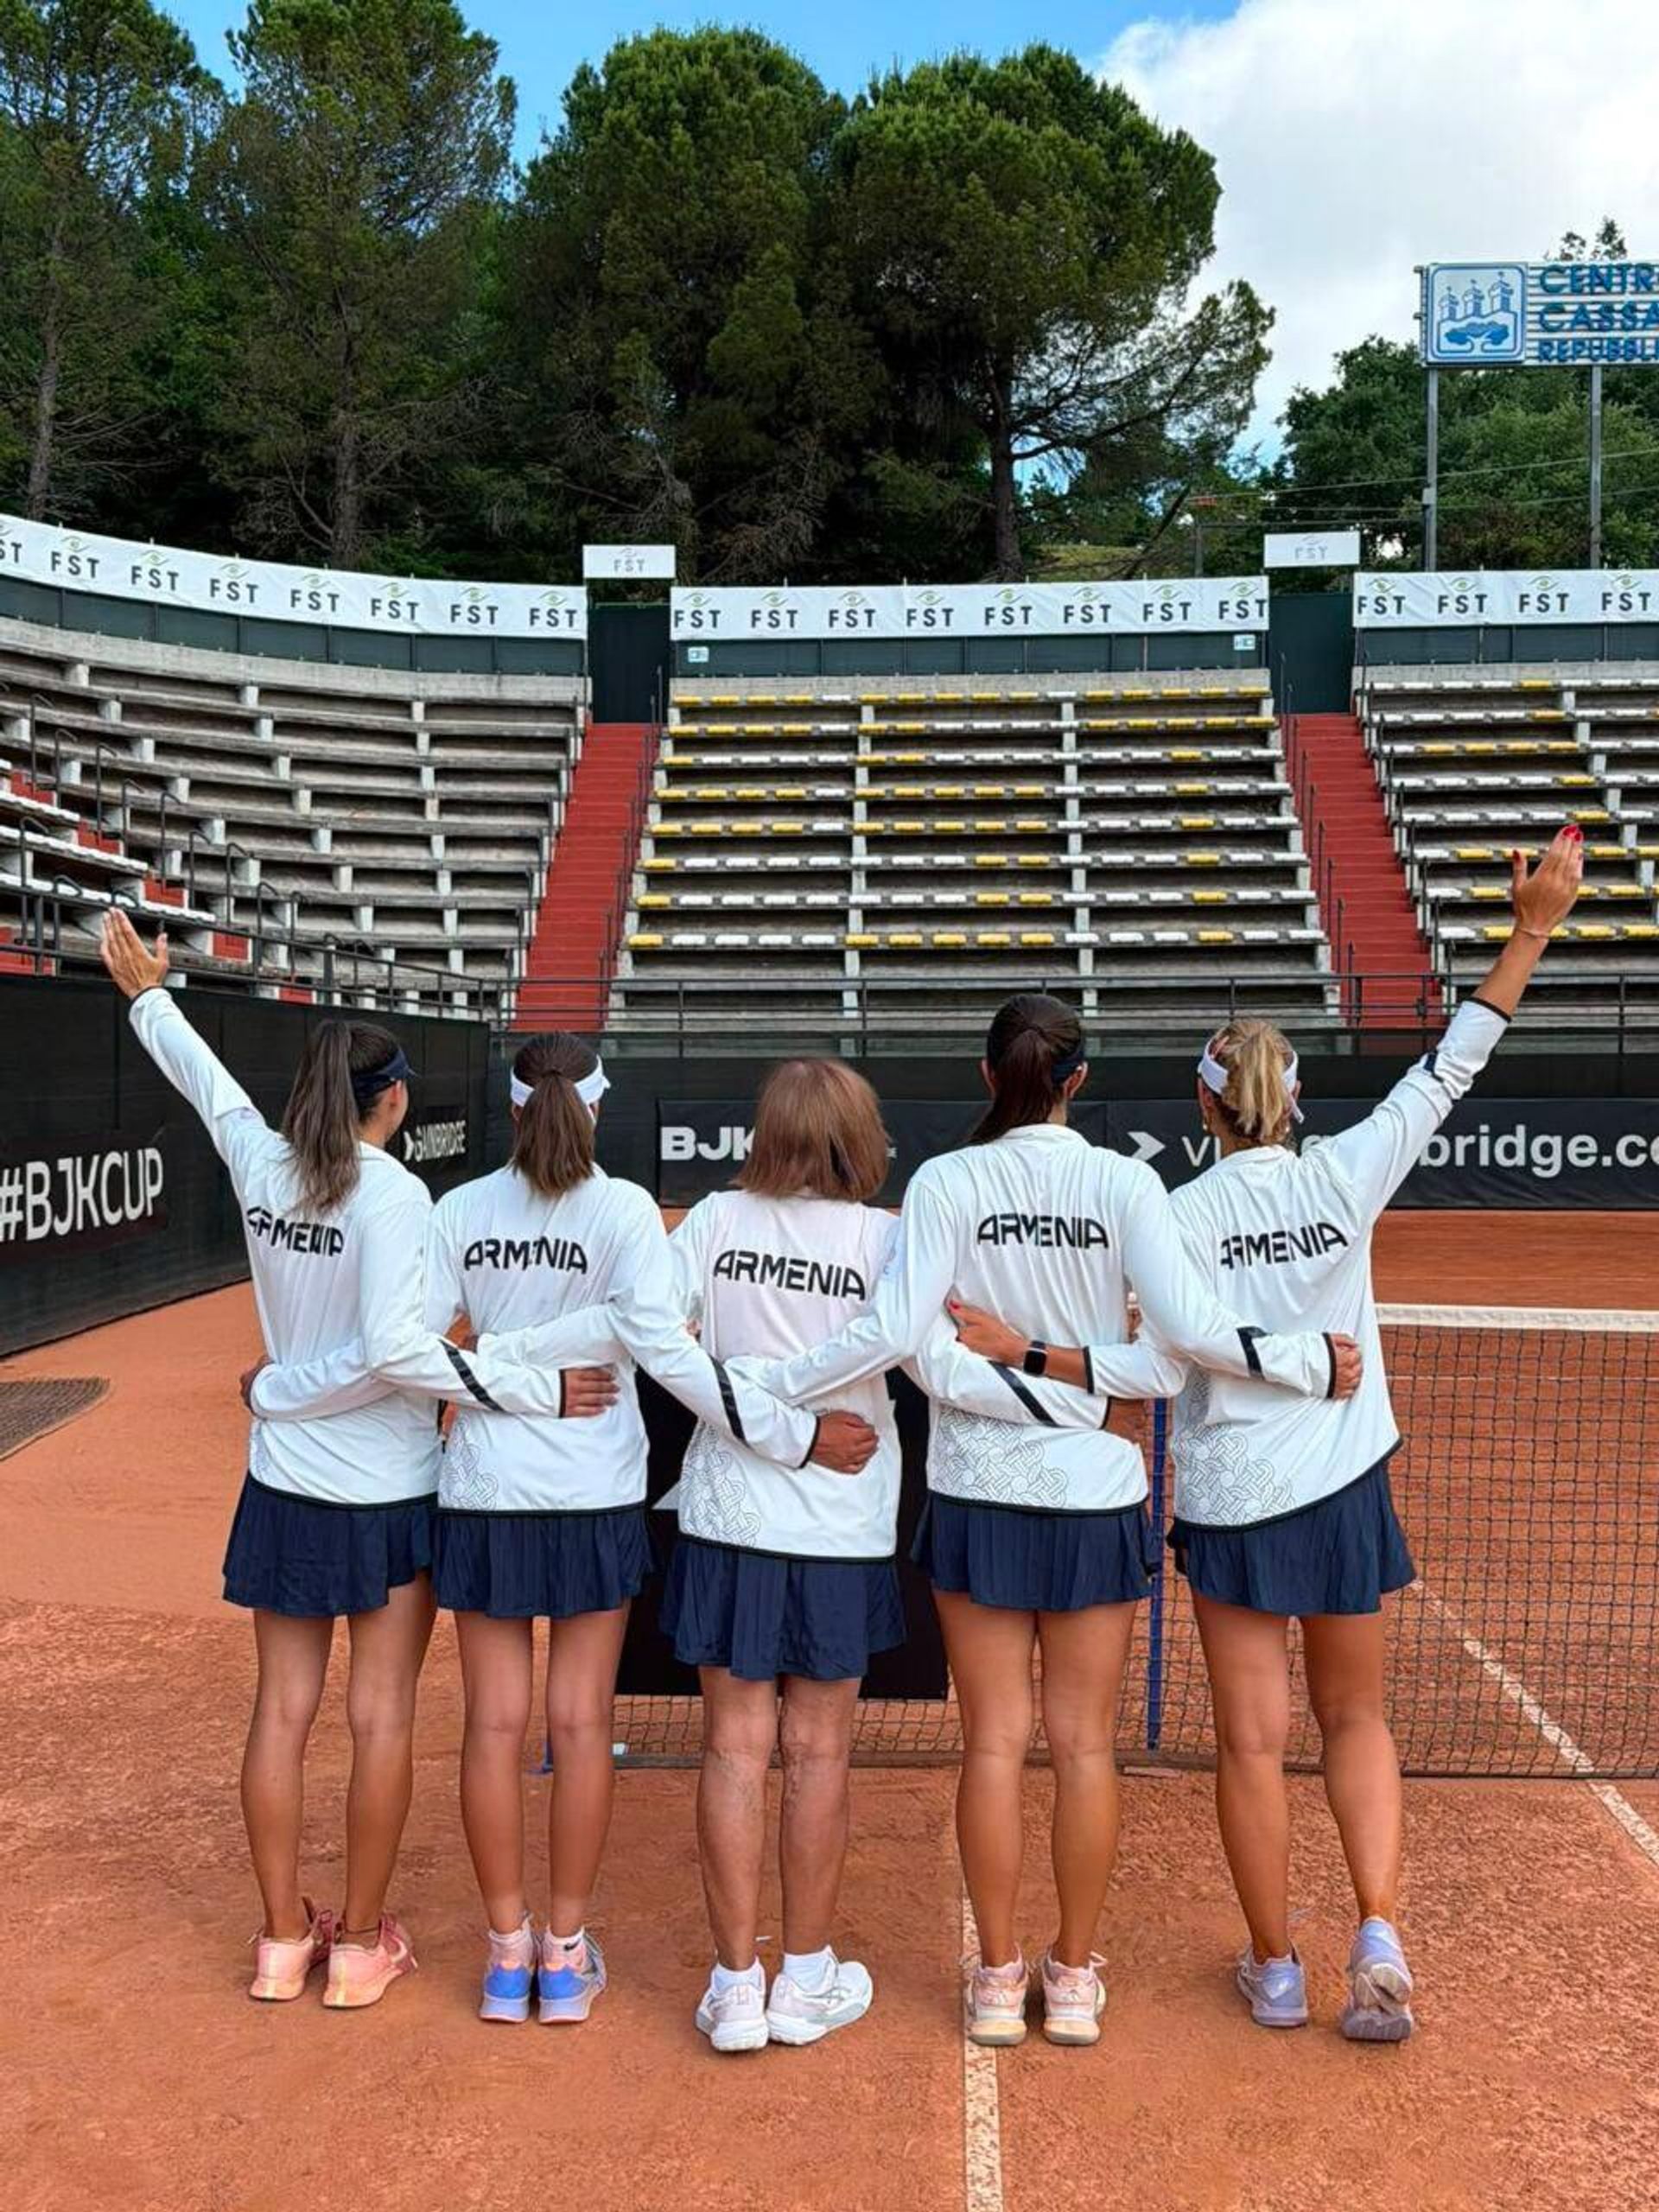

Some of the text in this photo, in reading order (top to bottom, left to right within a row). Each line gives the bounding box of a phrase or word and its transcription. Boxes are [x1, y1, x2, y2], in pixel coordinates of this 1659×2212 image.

[1540, 264, 1659, 293] CENTR
[613, 559, 645, 573] FST
[51, 551, 99, 578] FST
[131, 565, 179, 590] FST
[210, 579, 258, 603] FST
[291, 589, 340, 612] FST
[371, 598, 419, 620] FST
[450, 604, 499, 625] FST
[530, 607, 577, 627] FST
[1357, 592, 1651, 615] FST FST FST FST
[674, 599, 1267, 628] FST FST FST FST FST FST FST FST
[661, 1127, 755, 1160] BJK
[0, 1147, 163, 1242] #BJKCUP
[977, 1213, 1109, 1249] ARMENIA
[464, 1236, 588, 1274] ARMNIA
[714, 1249, 866, 1300] ARMENIA
